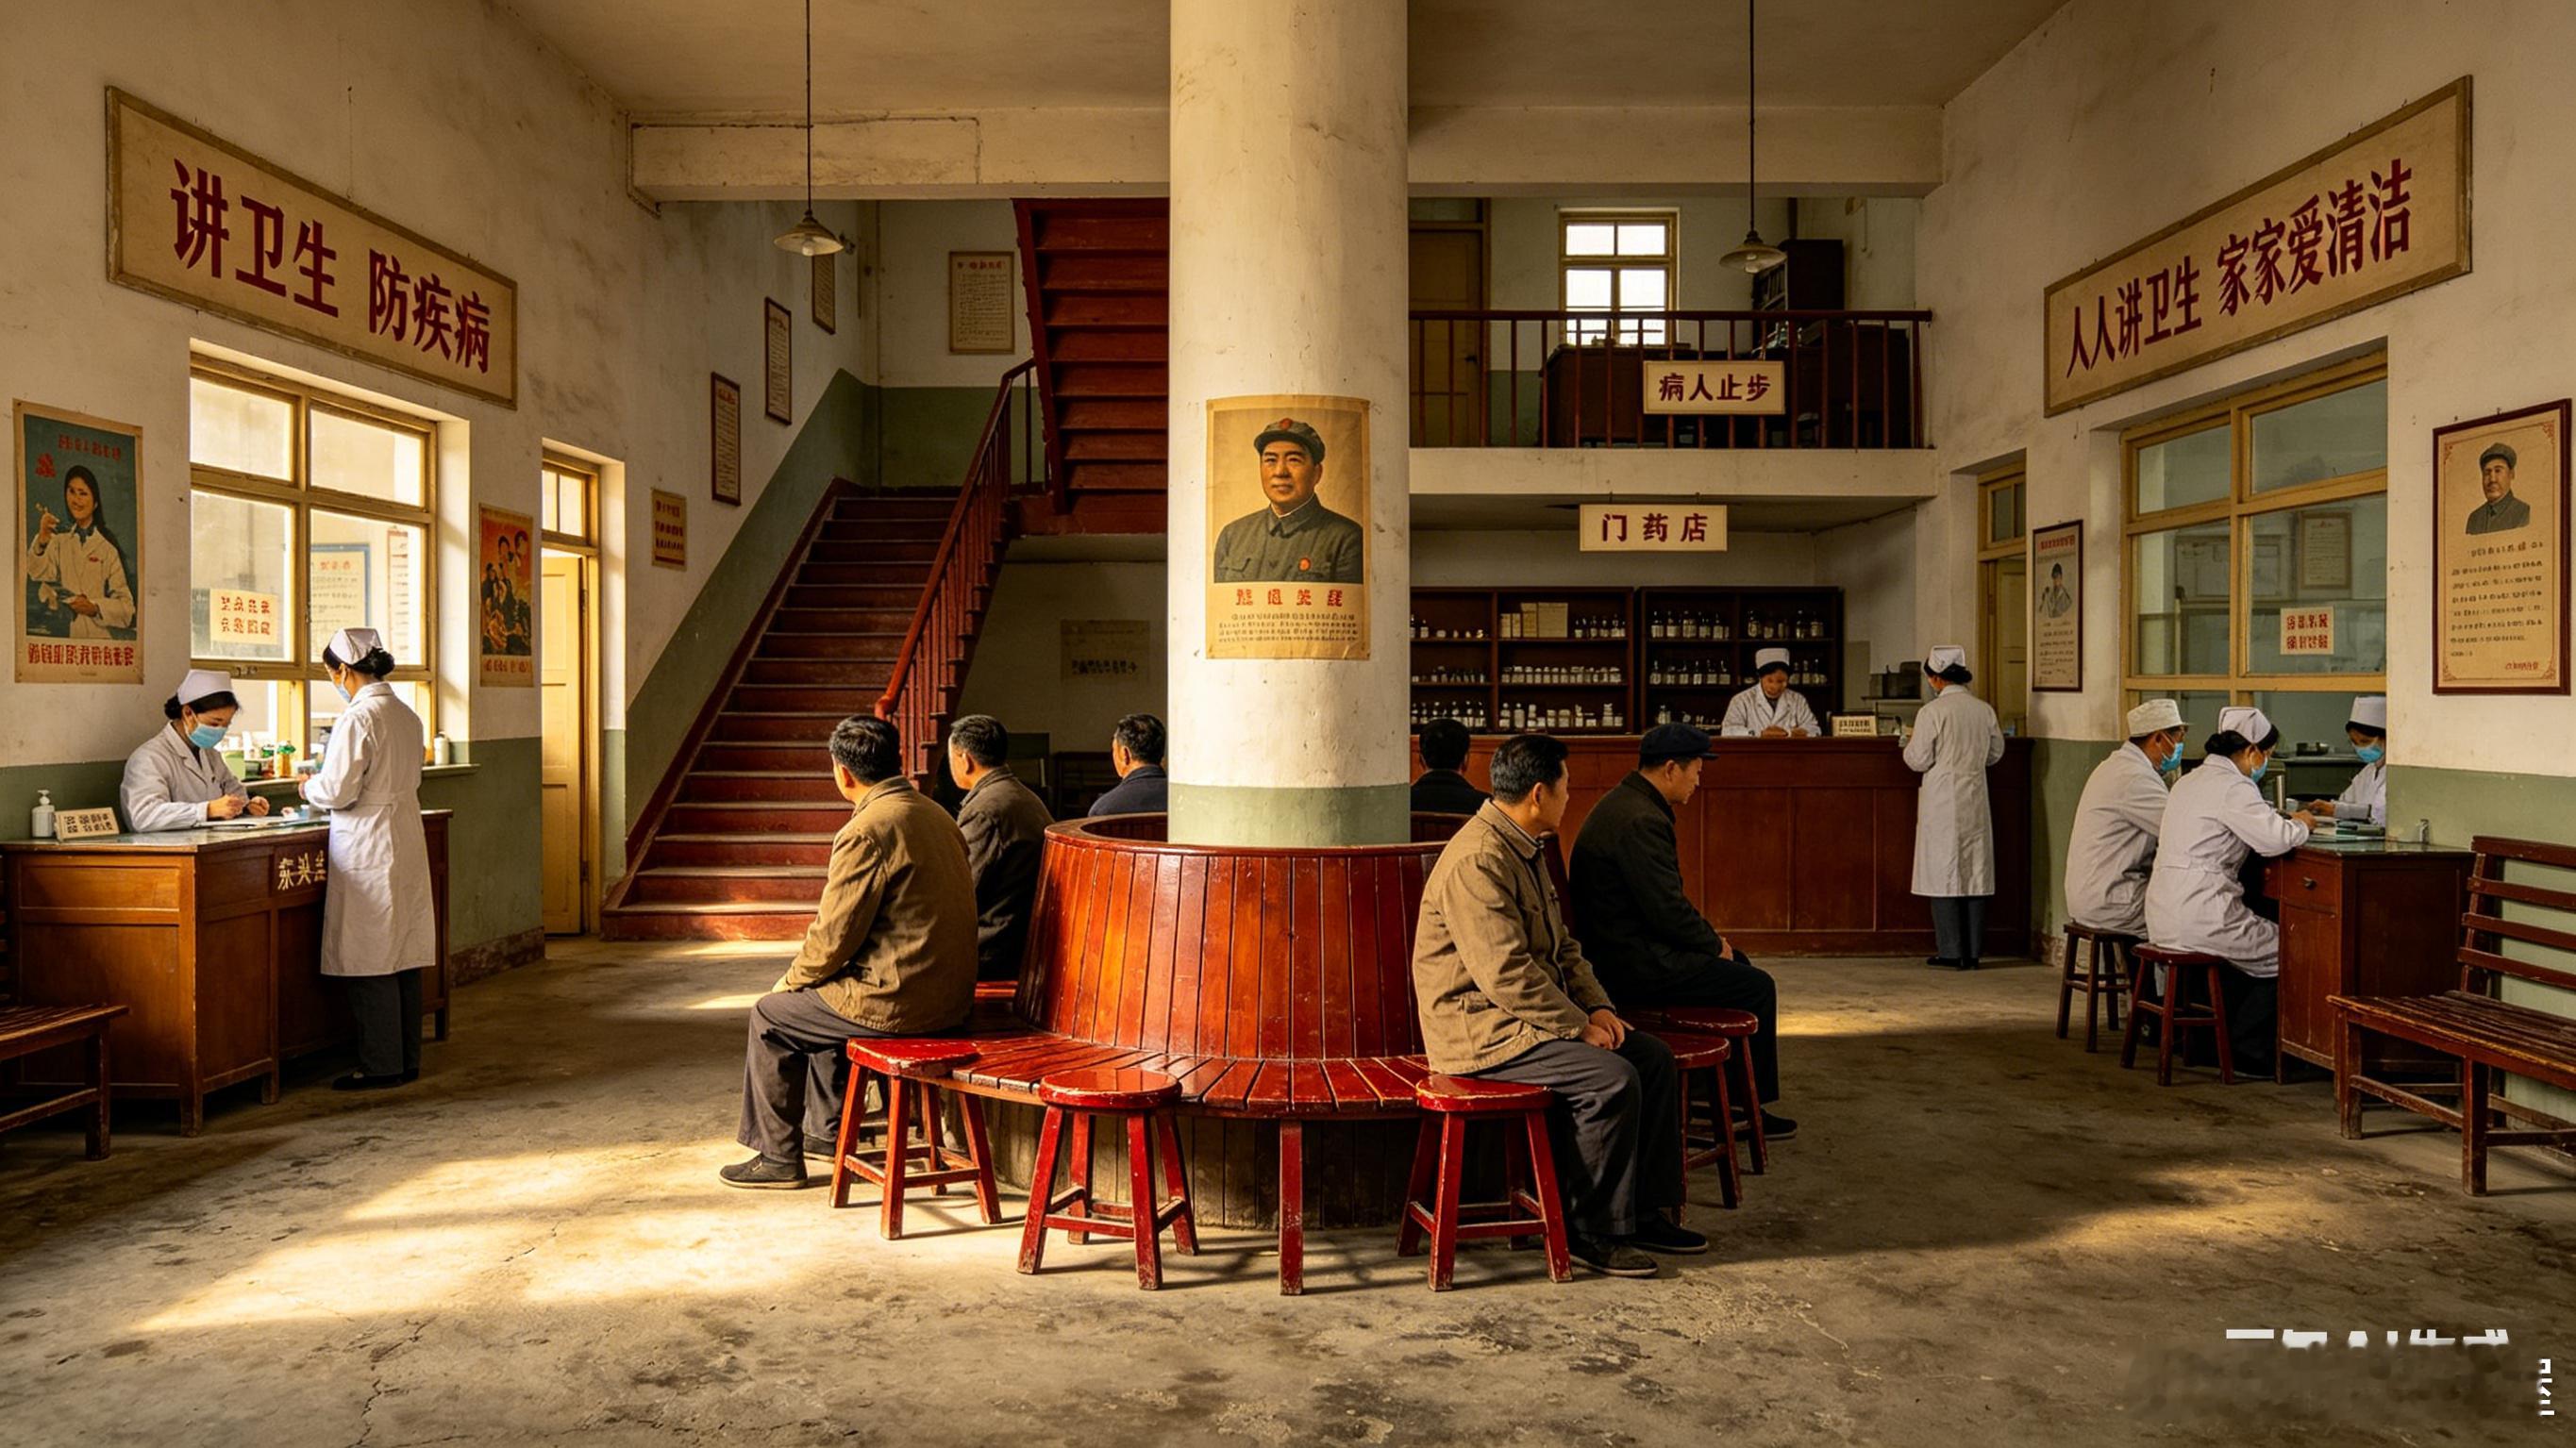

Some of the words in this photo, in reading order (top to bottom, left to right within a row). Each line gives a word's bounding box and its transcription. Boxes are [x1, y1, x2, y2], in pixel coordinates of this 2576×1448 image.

[171, 158, 339, 318] 讲卫生
[369, 248, 491, 374] 防疾病
[2066, 256, 2202, 379] 人人讲卫生
[2217, 158, 2413, 317] 家家爱清洁
[1659, 373, 1771, 402] 病人止步
[1601, 512, 1709, 542] 门药店
